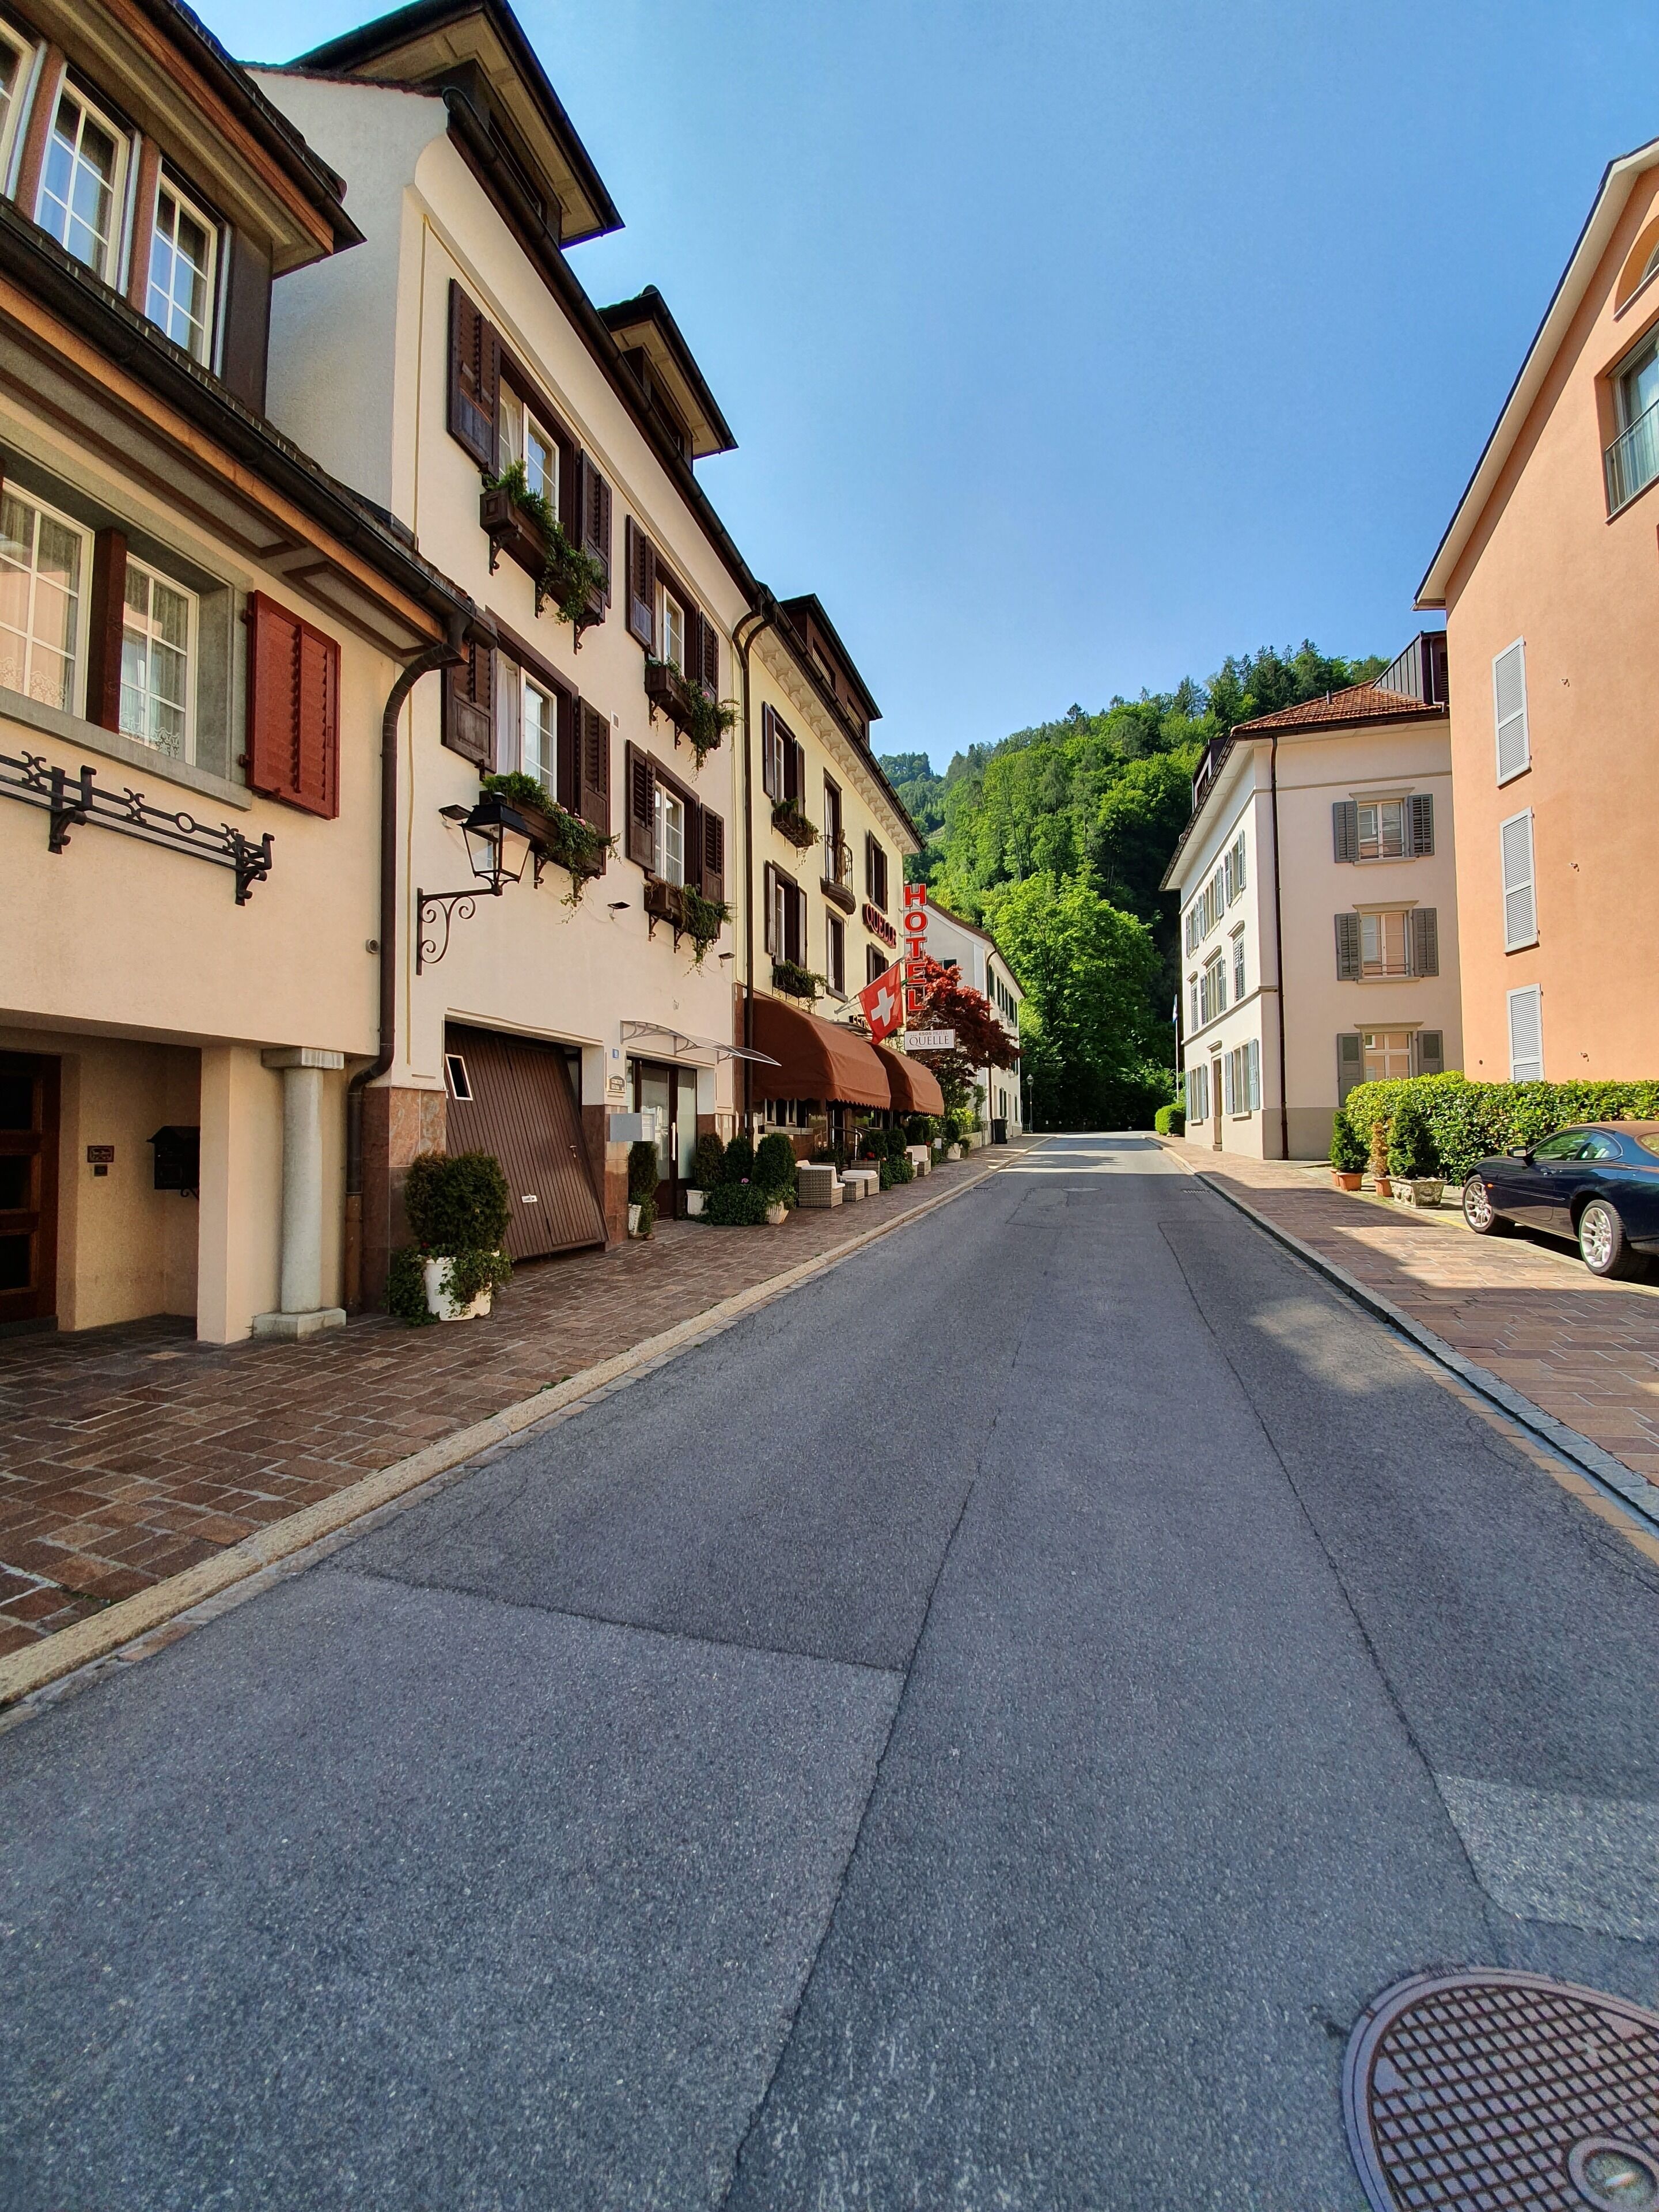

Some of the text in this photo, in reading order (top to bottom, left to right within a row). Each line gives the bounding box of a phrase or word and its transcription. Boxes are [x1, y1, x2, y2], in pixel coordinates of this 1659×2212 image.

[863, 904, 896, 949] QUELLE
[904, 883, 928, 1011] HOTEL
[909, 1035, 949, 1048] QUELLE
